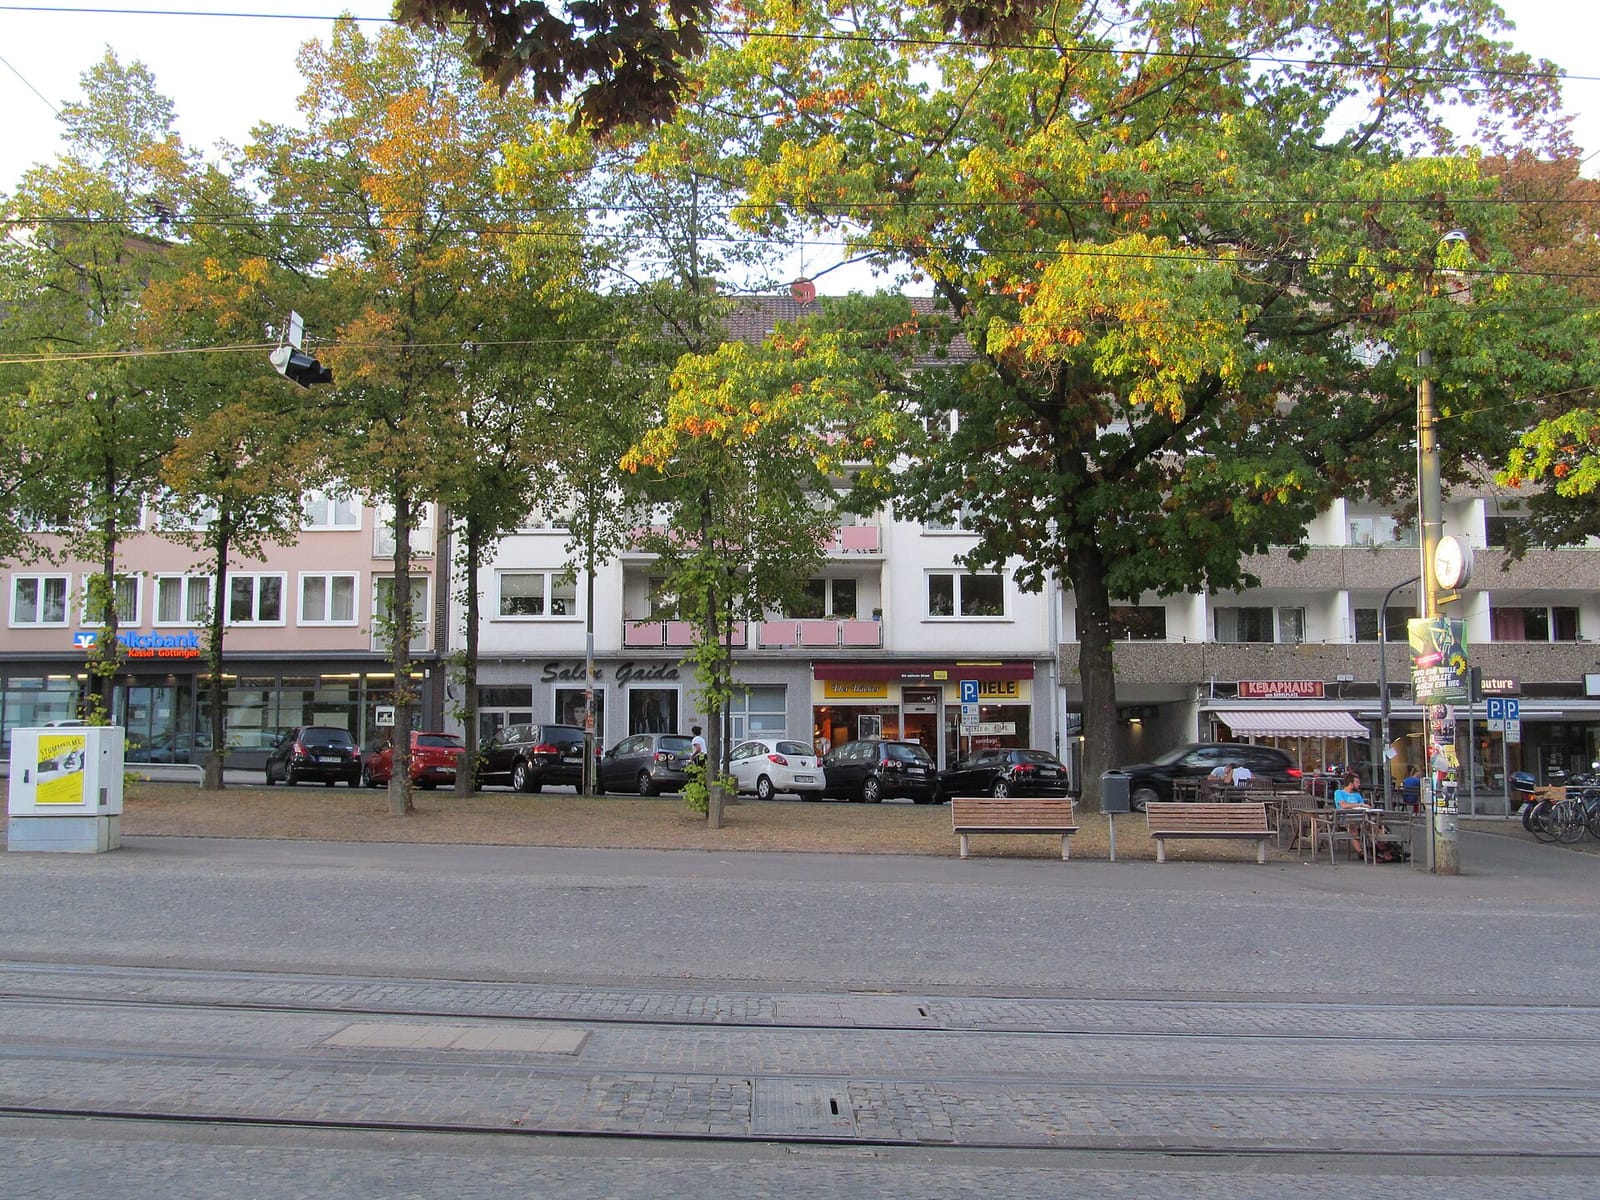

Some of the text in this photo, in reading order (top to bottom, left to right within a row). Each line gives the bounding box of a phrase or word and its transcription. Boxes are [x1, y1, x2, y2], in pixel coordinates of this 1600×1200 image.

[112, 631, 199, 648] olksbank
[128, 648, 154, 657] Kassel
[615, 662, 680, 688] Gaida
[1428, 674, 1452, 682] SOLLTE
[978, 681, 1016, 694] IELE
[1249, 682, 1314, 693] KEBAPHAUS
[1480, 679, 1513, 689] outure
[964, 683, 974, 701] P
[1490, 700, 1500, 718] P
[1507, 701, 1516, 718] P
